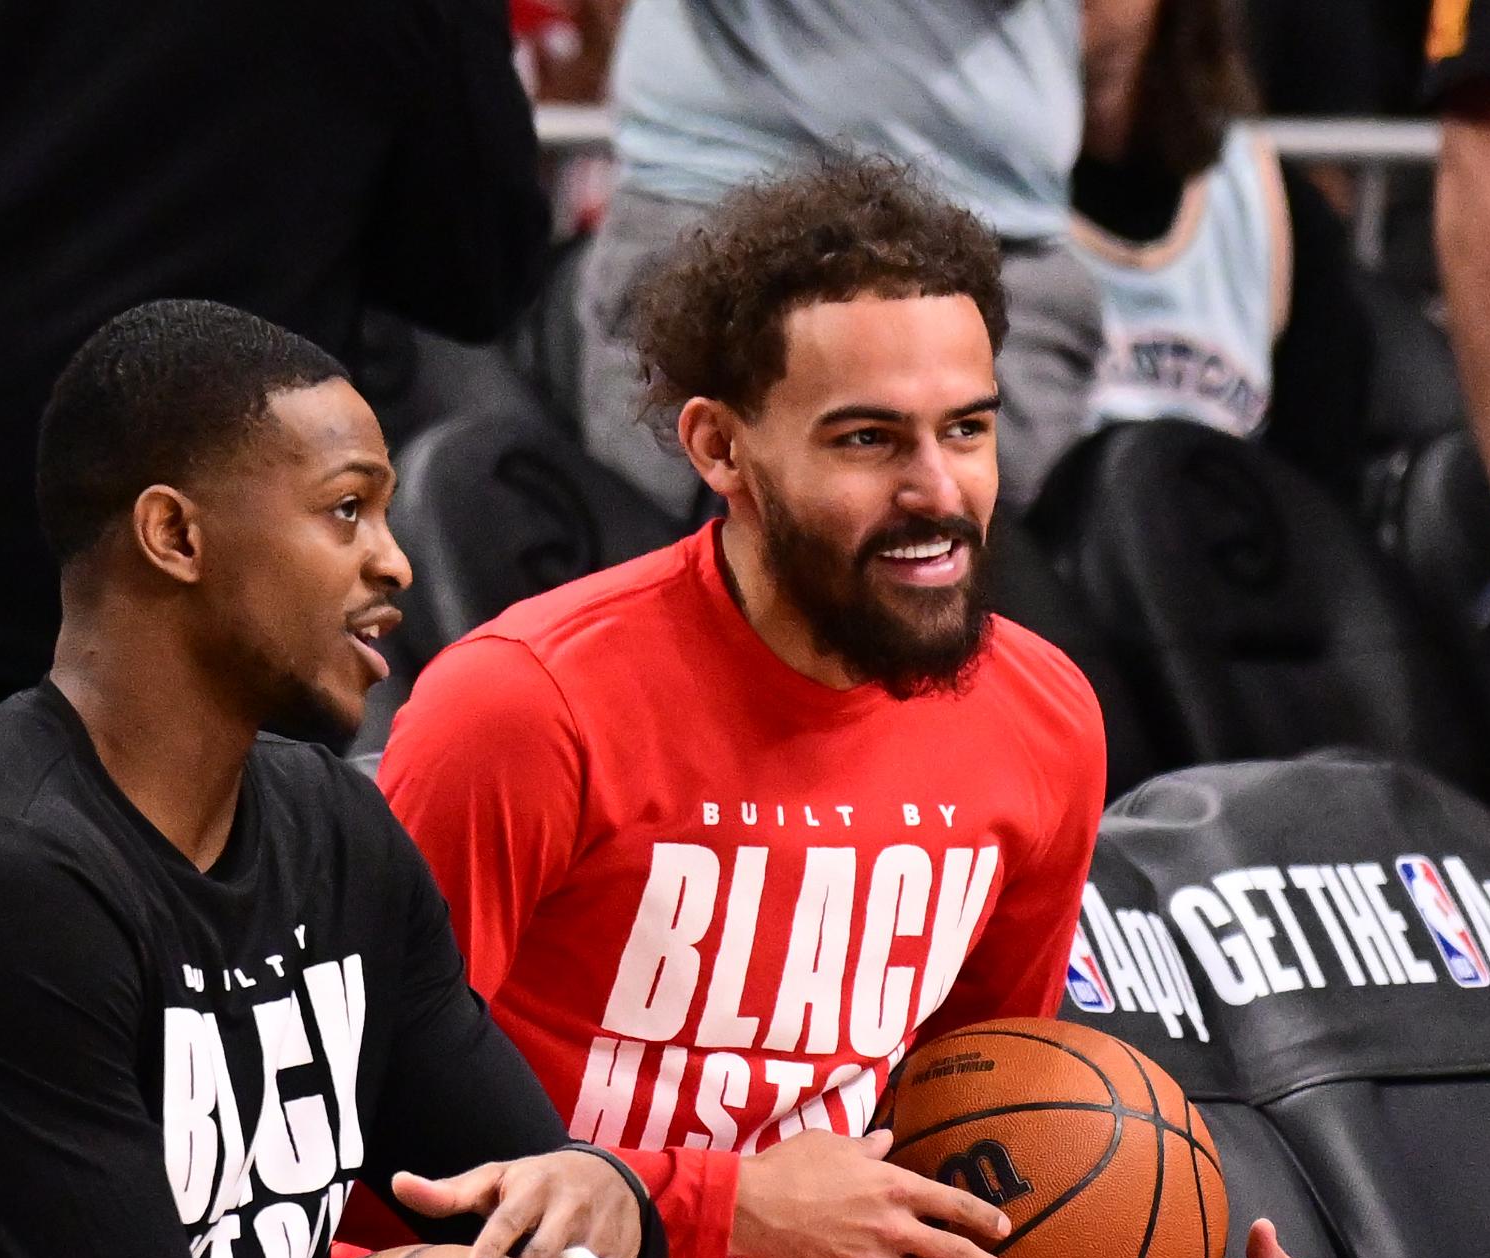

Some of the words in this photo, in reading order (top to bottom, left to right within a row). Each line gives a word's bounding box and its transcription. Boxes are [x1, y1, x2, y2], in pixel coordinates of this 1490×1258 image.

[703, 802, 854, 827] BUILT
[903, 803, 957, 827] BY
[601, 842, 1000, 1058] BLACK
[1170, 865, 1325, 1006] GET
[1289, 862, 1437, 986] THE
